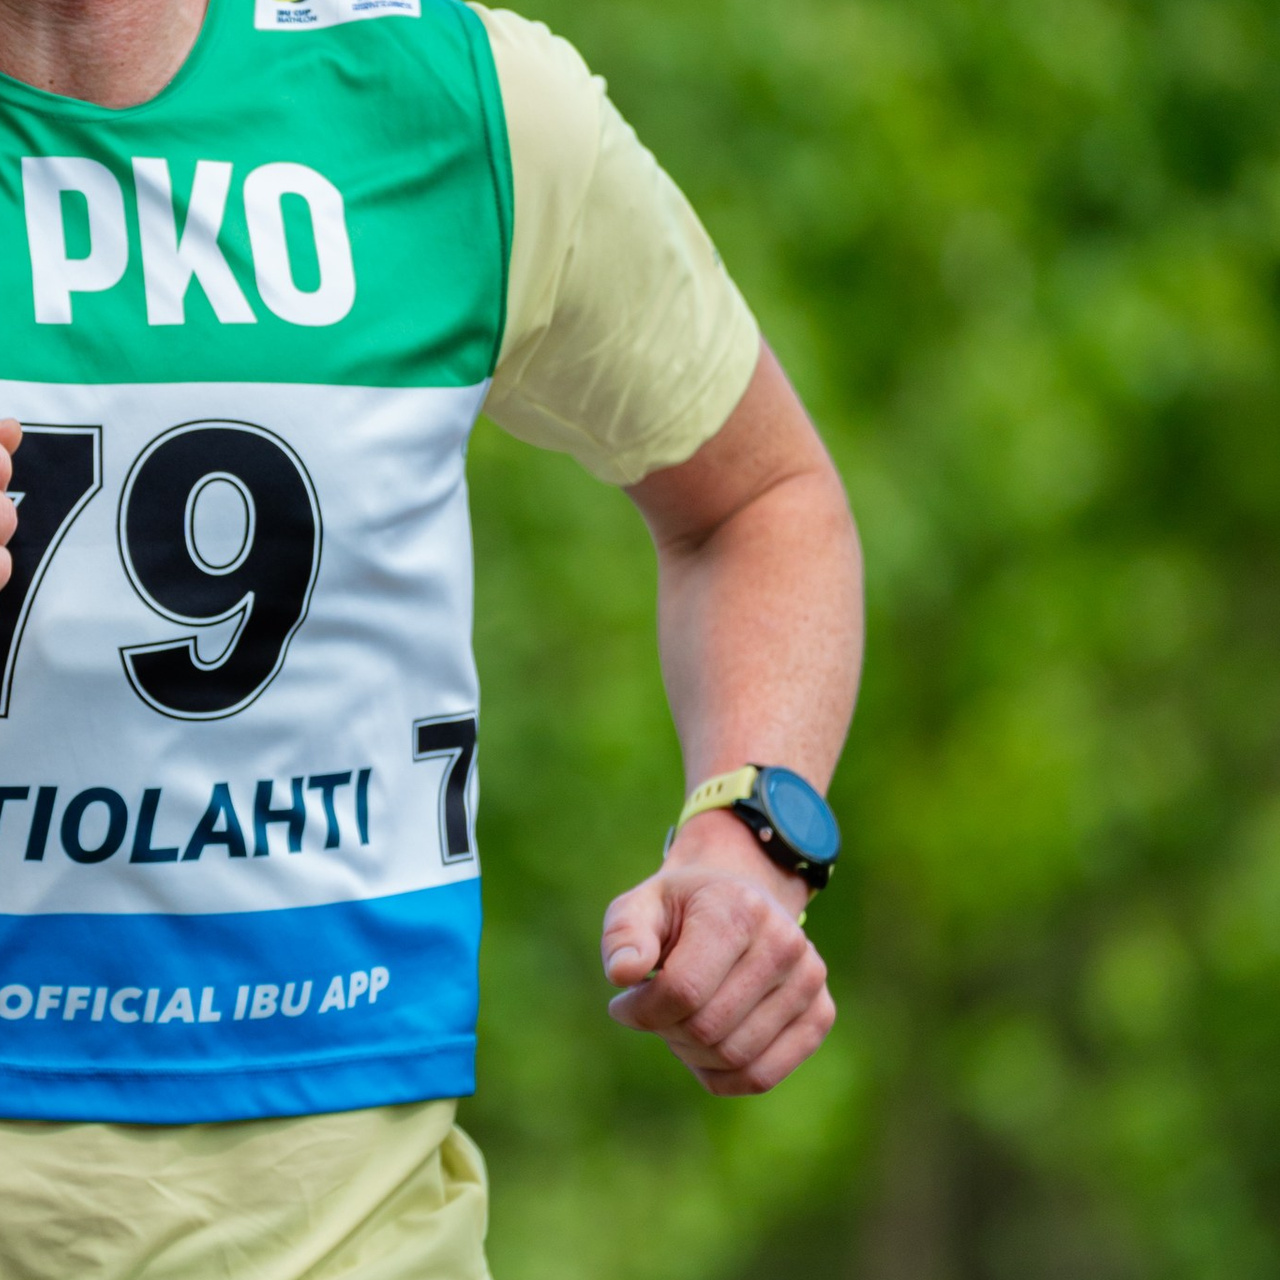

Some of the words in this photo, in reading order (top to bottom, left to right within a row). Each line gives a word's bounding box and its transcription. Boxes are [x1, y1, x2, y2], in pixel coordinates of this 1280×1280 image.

[21, 156, 356, 326] PKO
[413, 709, 478, 866] 7
[233, 980, 314, 1021] IBU
[319, 966, 391, 1014] APP
